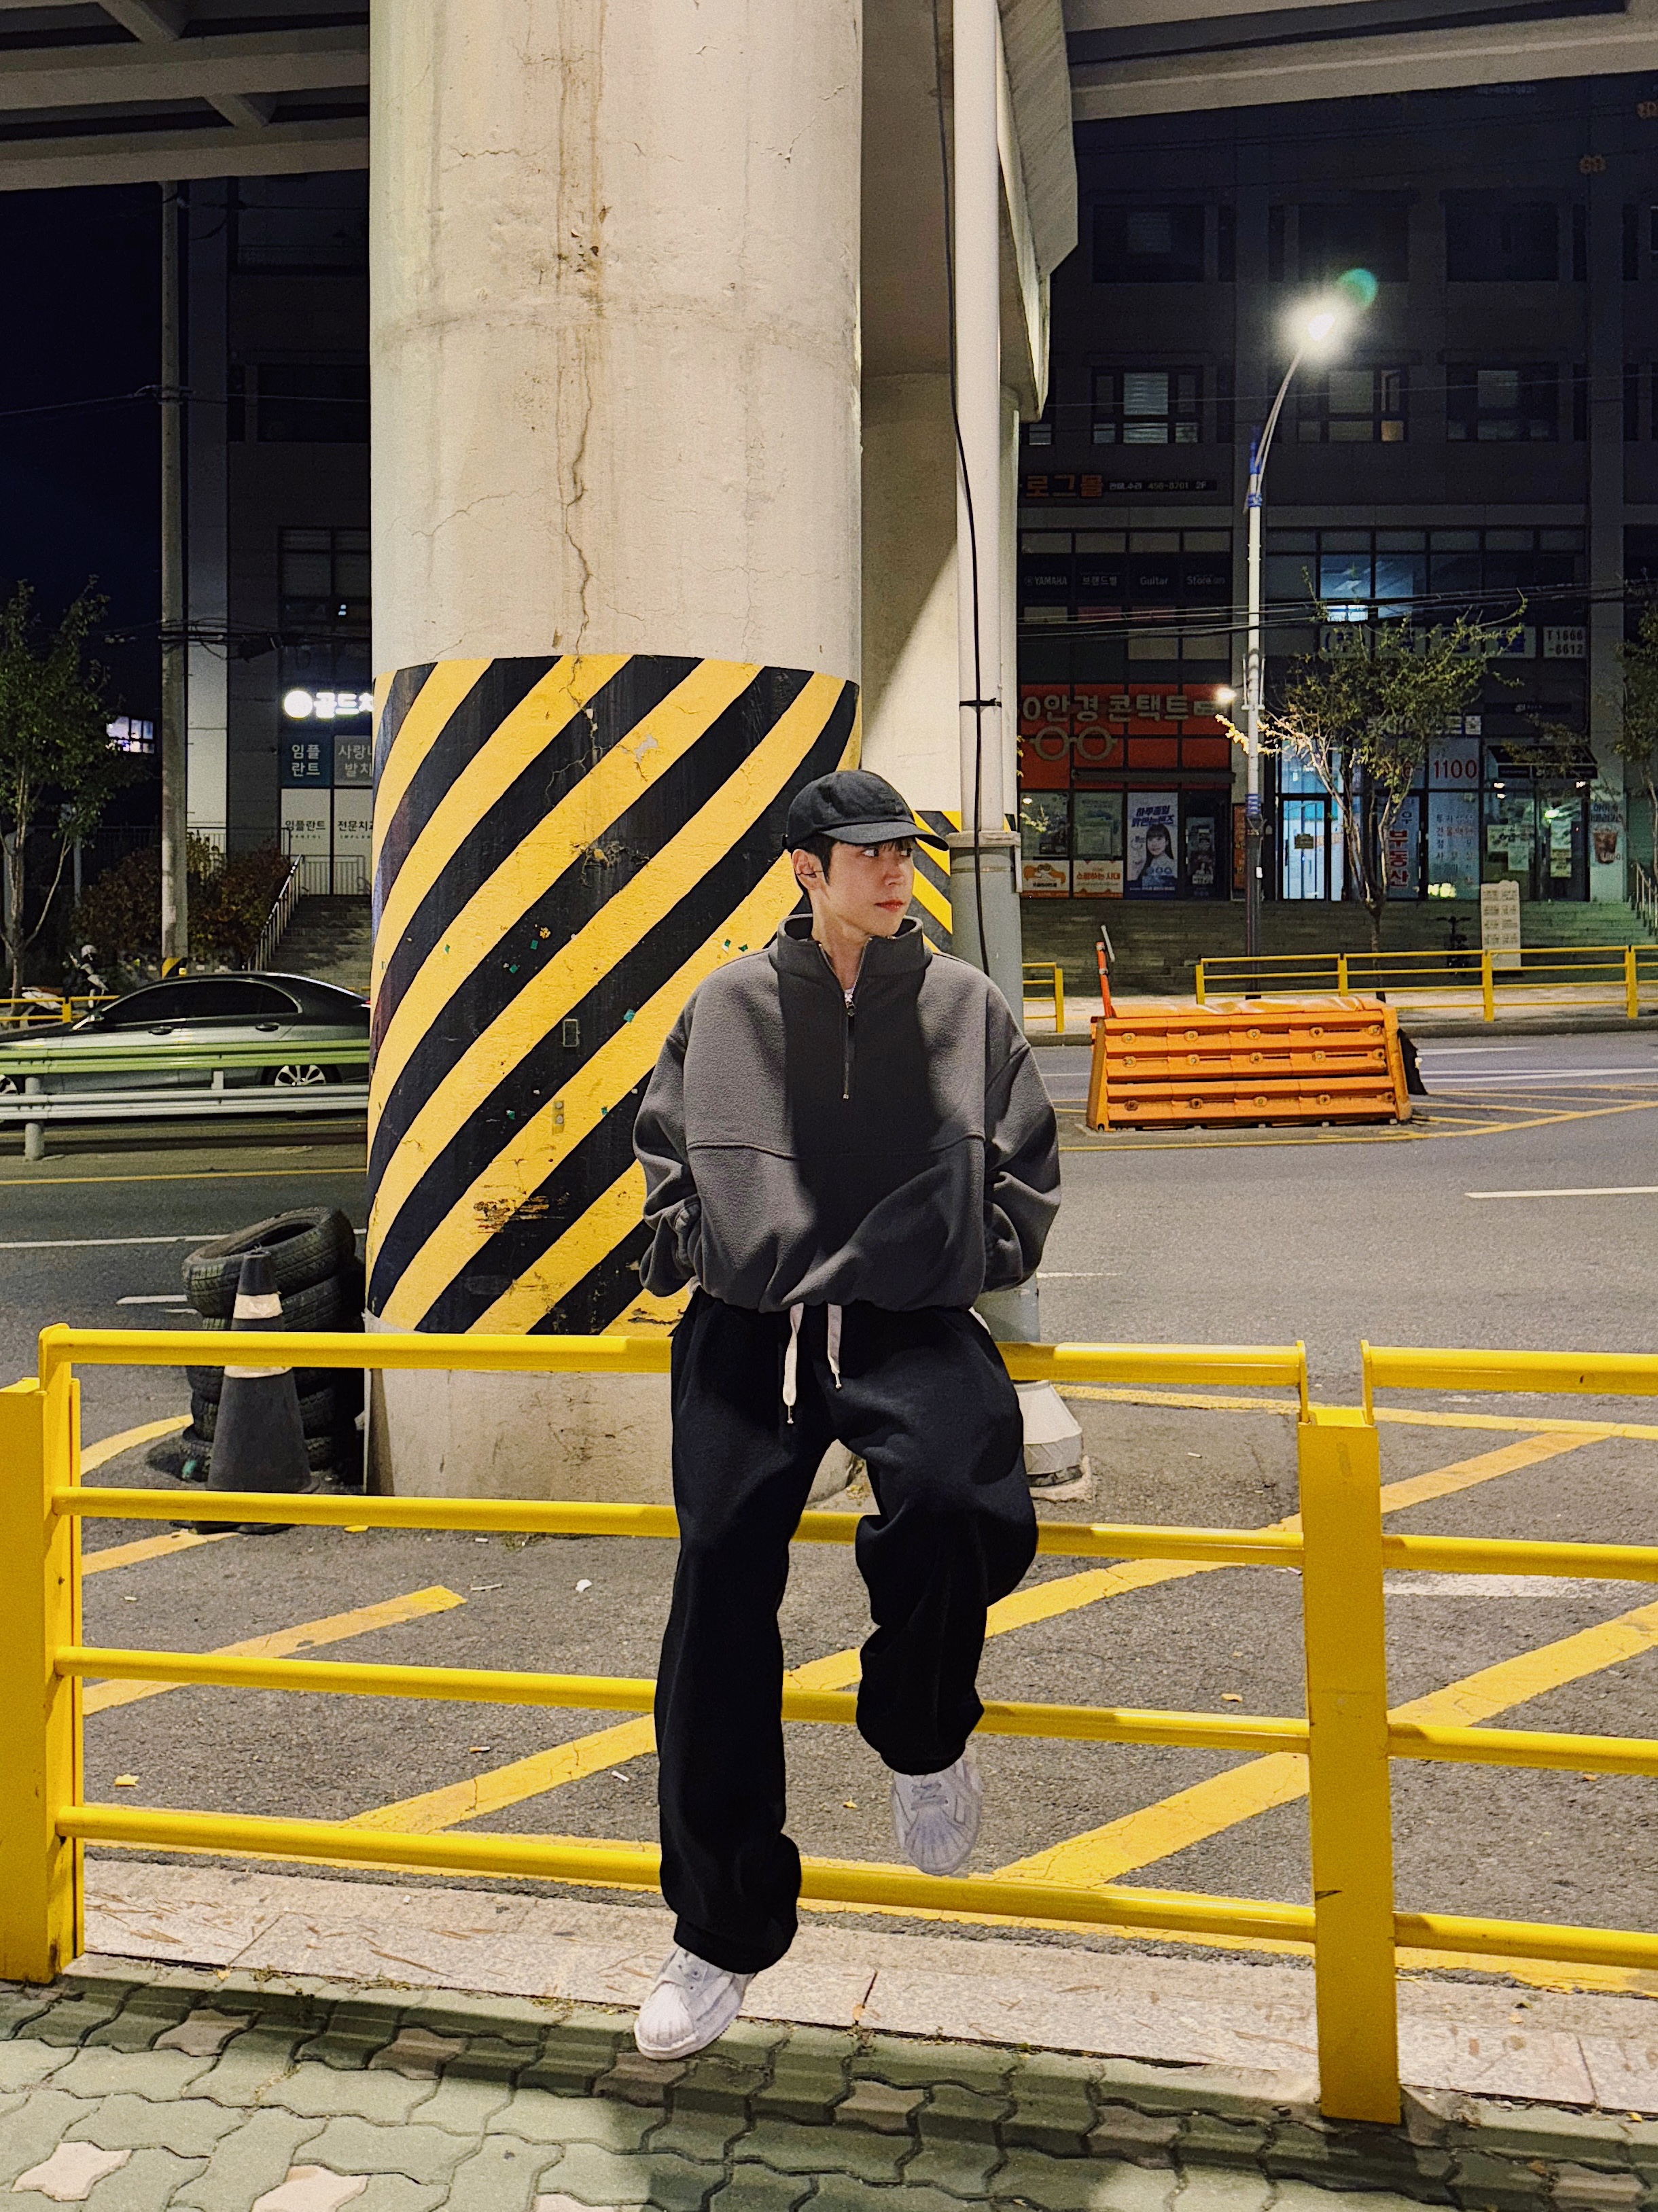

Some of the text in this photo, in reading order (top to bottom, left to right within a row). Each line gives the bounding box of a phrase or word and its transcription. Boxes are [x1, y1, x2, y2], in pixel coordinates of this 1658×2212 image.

[1035, 576, 1068, 585] YAMAHA
[1140, 576, 1169, 585] Guitar
[1108, 695, 1189, 722] 콘택트
[291, 743, 321, 760] 임플
[291, 762, 321, 777] 란트
[1433, 759, 1477, 779] 1100
[1389, 830, 1409, 888] 부동산
